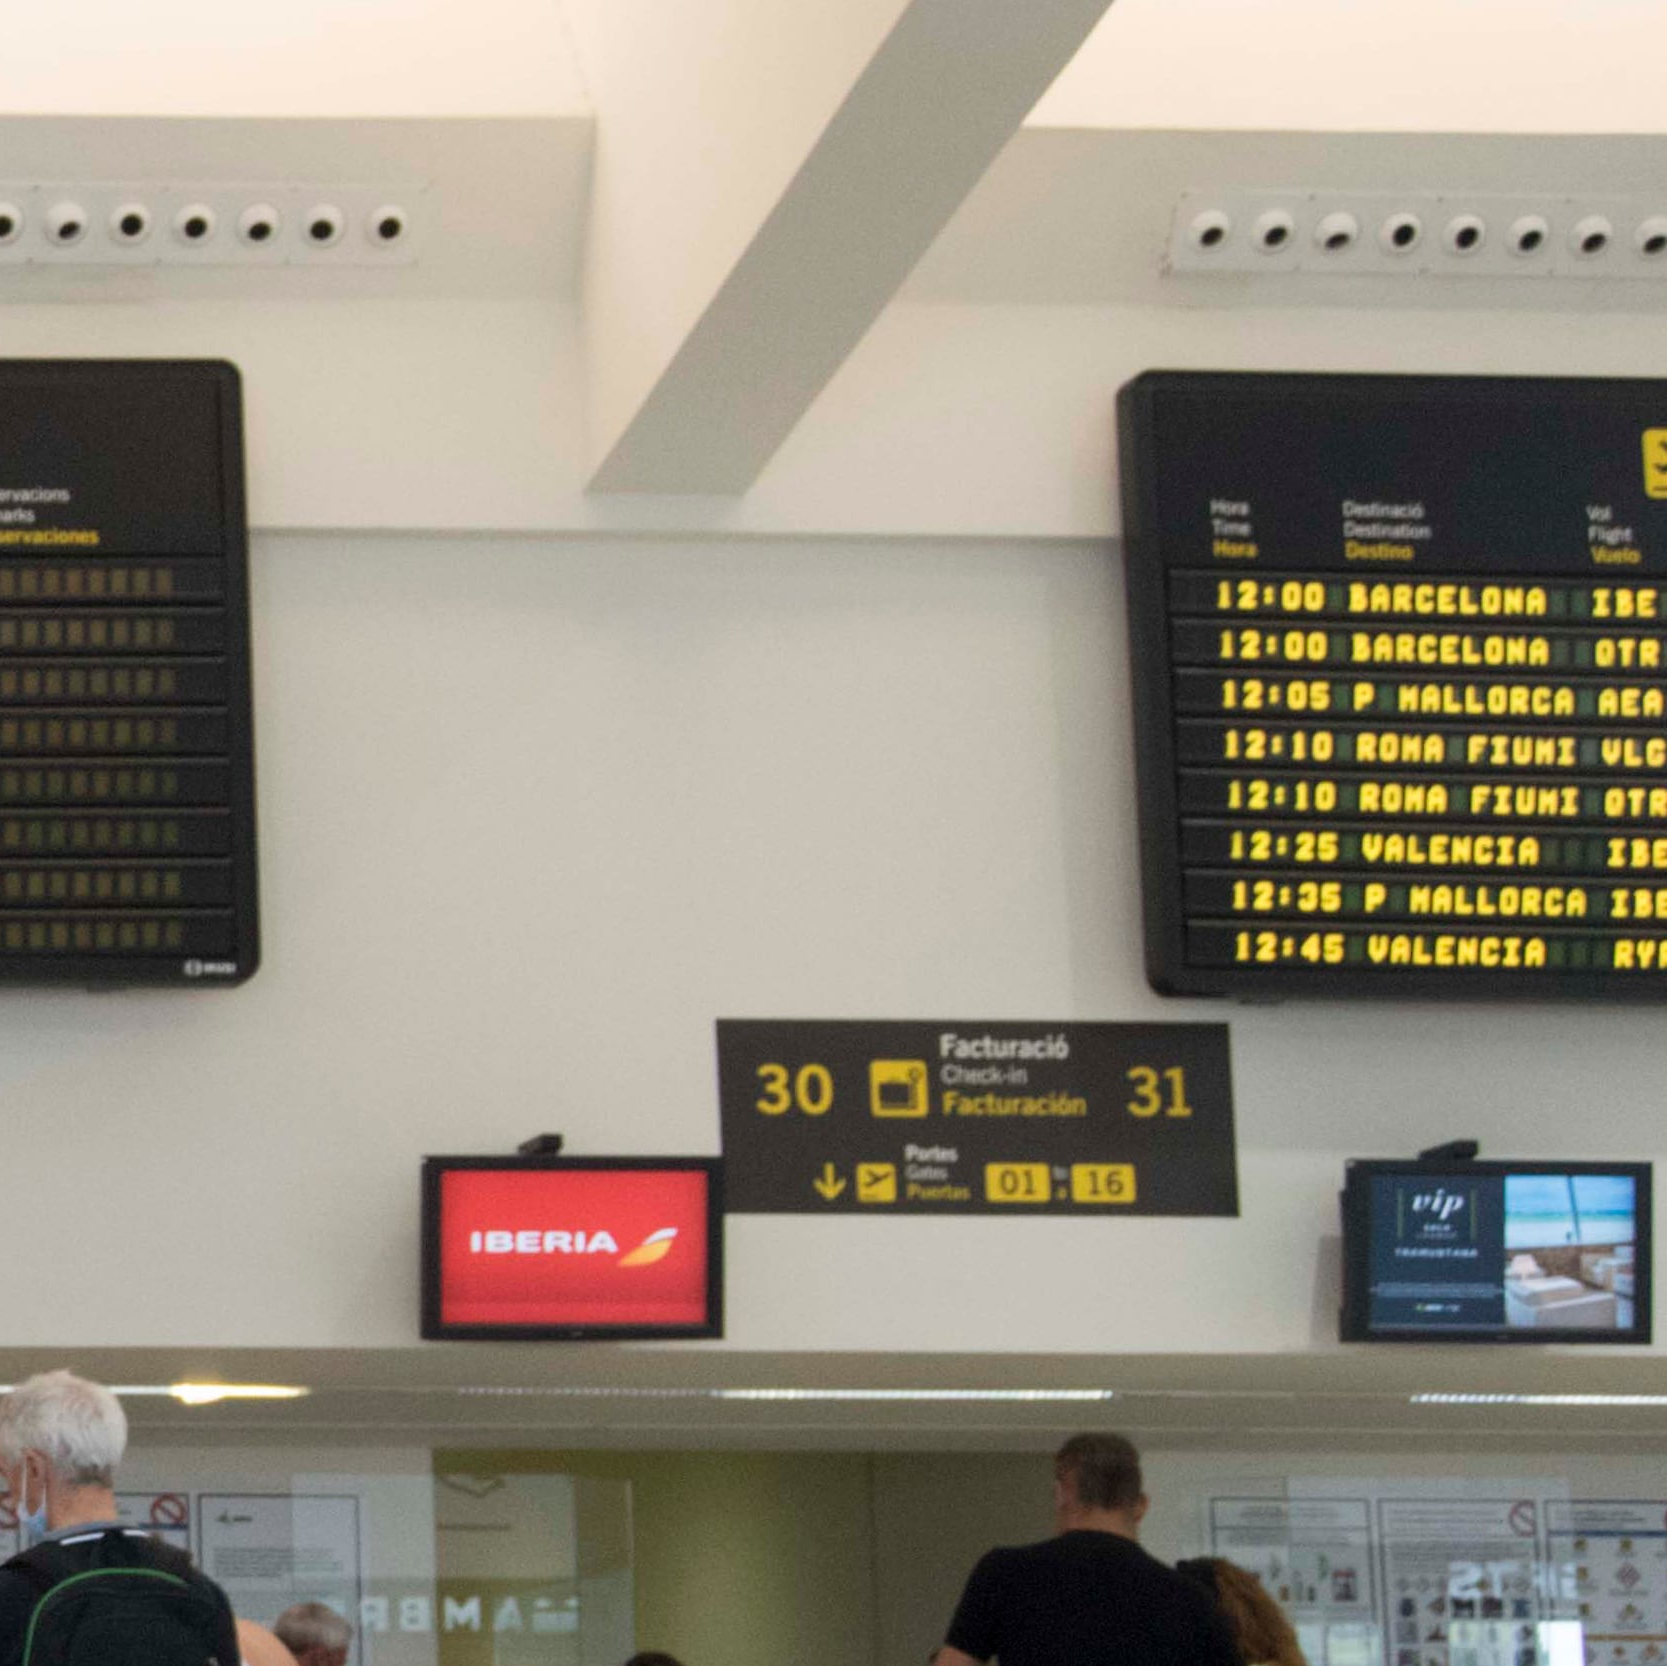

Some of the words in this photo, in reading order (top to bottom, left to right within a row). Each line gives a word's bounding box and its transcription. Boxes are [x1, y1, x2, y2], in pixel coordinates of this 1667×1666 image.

[1219, 581, 1324, 611] 12:00
[1350, 583, 1546, 615] BARCELONA
[1221, 630, 1327, 660] 12:00
[1353, 634, 1549, 665] BARCELONA
[1224, 680, 1330, 710] 12:05
[1354, 683, 1374, 710] P
[1399, 685, 1574, 715] MALLORCA
[1226, 730, 1333, 760] 12:10
[1357, 733, 1444, 762] ROMA
[1468, 735, 1574, 765] FIUMI
[1229, 781, 1336, 811] 12:10
[1360, 783, 1447, 812] ROMA
[1471, 786, 1578, 815] FIUMI
[1232, 831, 1337, 861] 12:25
[1362, 834, 1539, 865] VALENCIA
[1234, 881, 1341, 911] 12:35
[1365, 884, 1386, 912] P
[1410, 886, 1586, 916] MALLORCA
[1237, 933, 1343, 962] 12:45
[1369, 936, 1545, 966] VALENCIA
[939, 1033, 1070, 1060] Facturació
[756, 1063, 835, 1116] 30
[939, 1064, 1028, 1088] Check-in
[1126, 1066, 1193, 1119] 31
[942, 1090, 1087, 1118] Facturación
[1000, 1169, 1037, 1196] 01
[1088, 1170, 1125, 1196] 16
[1412, 1188, 1465, 1220] vip
[470, 1230, 619, 1254] IBERIA
